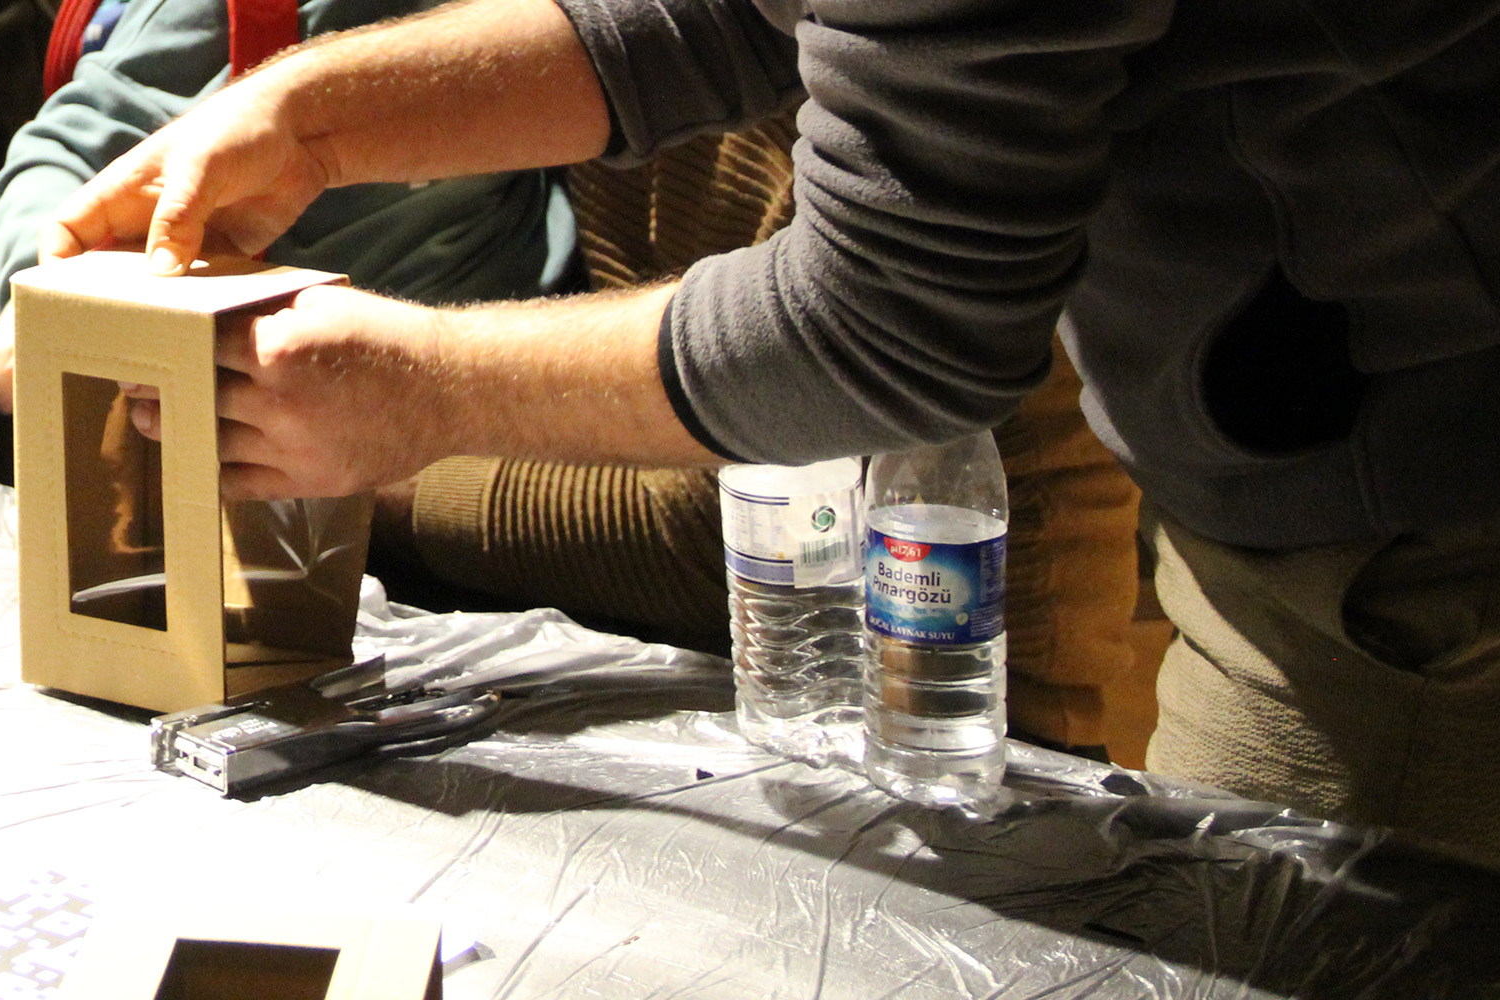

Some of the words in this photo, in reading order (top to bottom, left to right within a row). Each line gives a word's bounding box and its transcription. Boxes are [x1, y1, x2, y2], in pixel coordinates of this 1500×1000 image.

[878, 561, 941, 587] Bademli
[872, 575, 951, 604] Pınargözü
[891, 624, 926, 639] KAYNAK
[929, 631, 955, 640] SUYU
